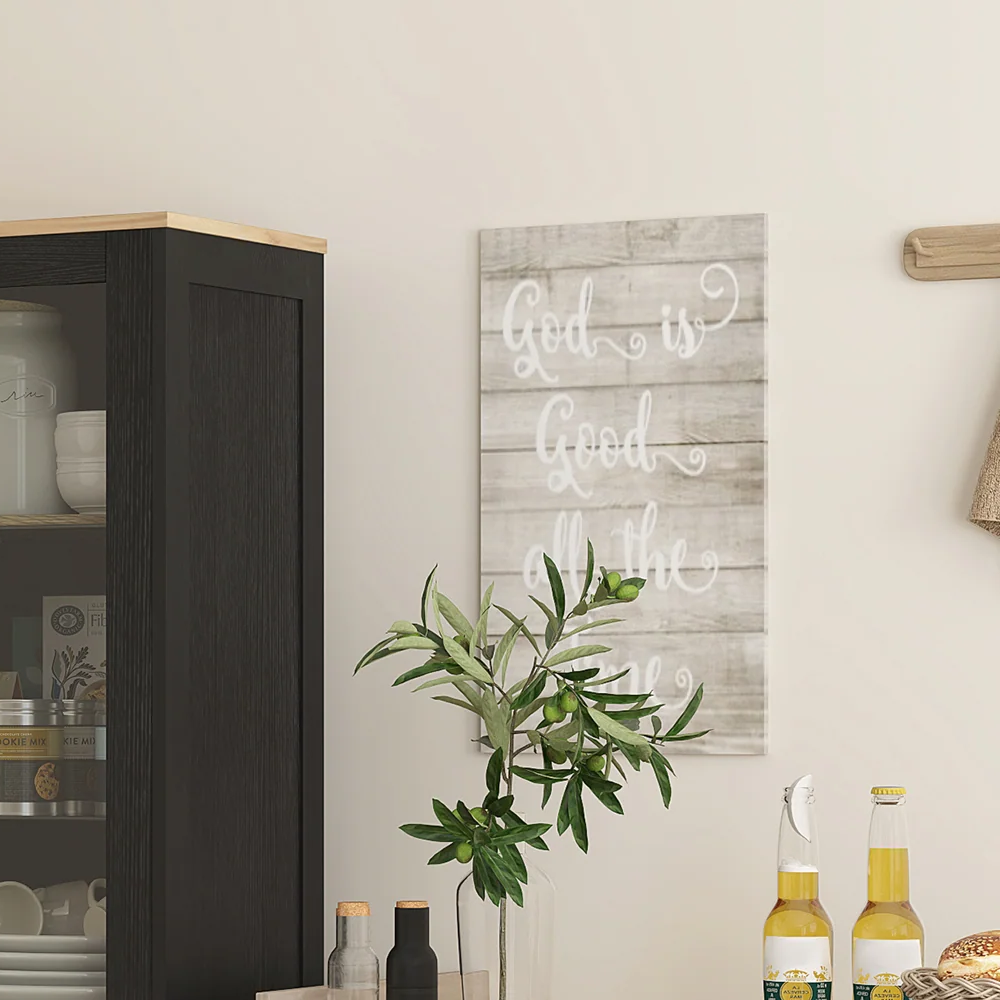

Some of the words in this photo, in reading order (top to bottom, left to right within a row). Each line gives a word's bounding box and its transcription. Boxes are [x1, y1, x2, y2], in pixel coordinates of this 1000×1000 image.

[502, 276, 646, 383] God
[661, 263, 739, 359] is
[536, 389, 706, 499] Good
[610, 501, 718, 594] the
[91, 613, 106, 627] Fib
[30, 738, 46, 746] MIX
[63, 737, 79, 745] KIE
